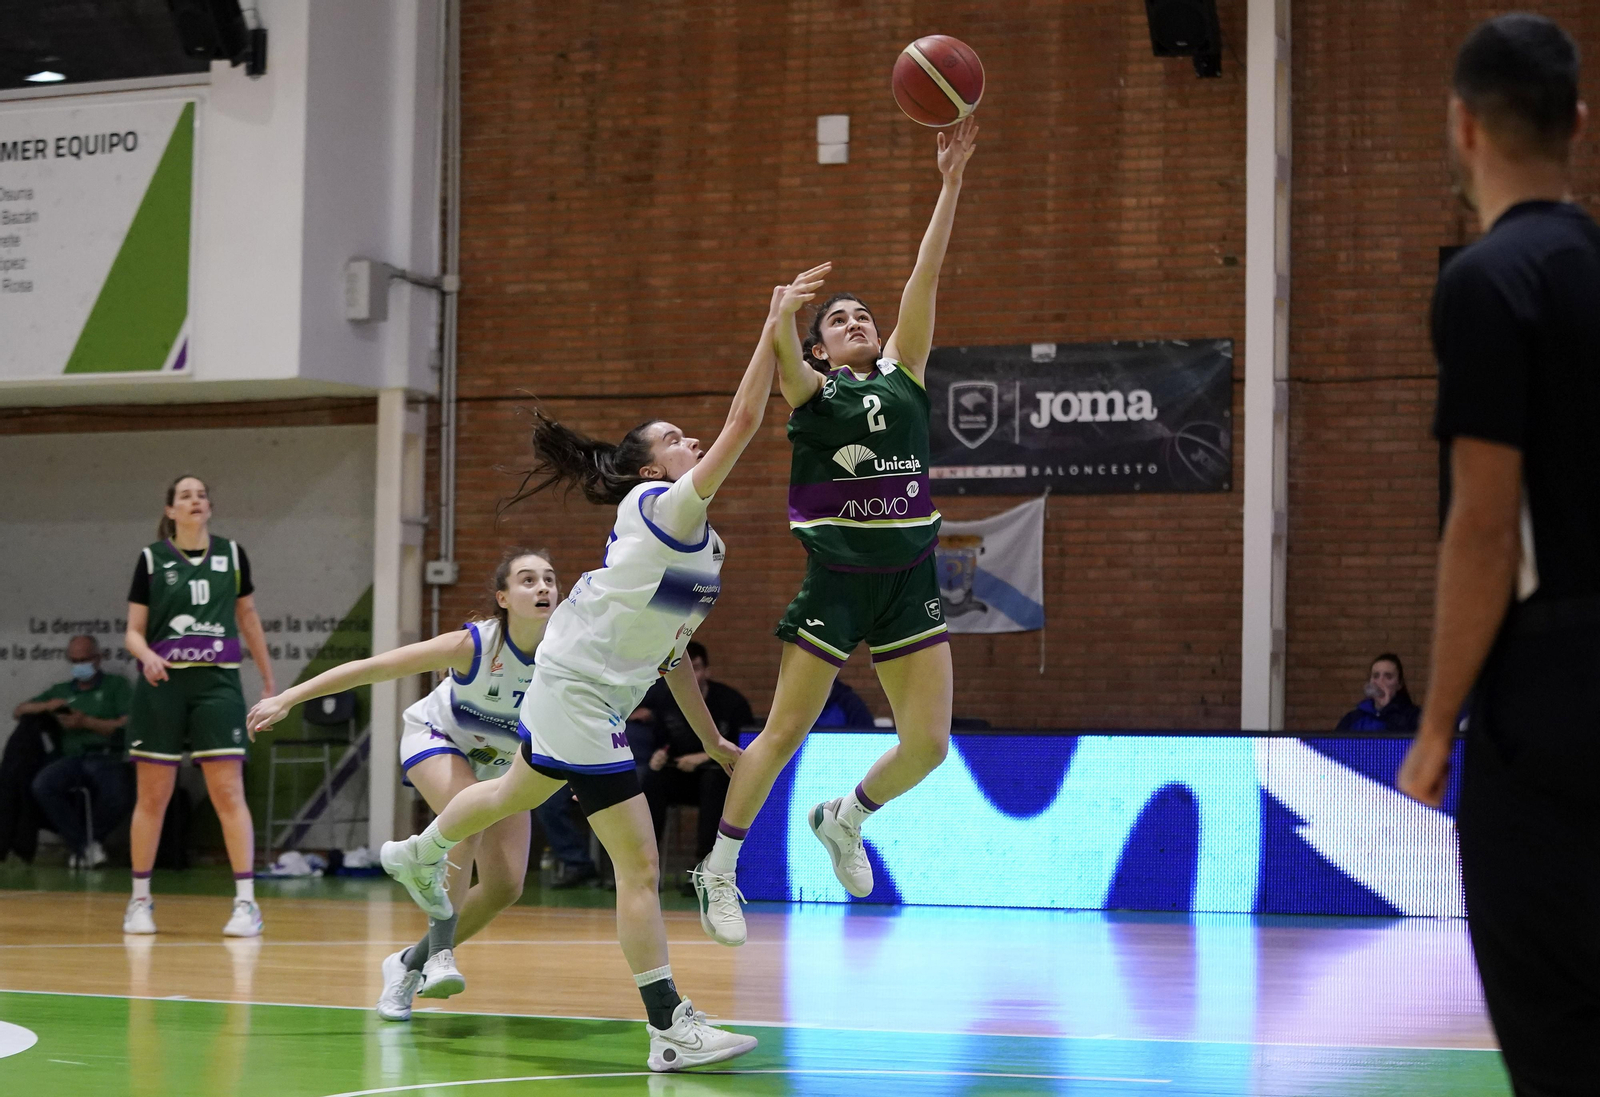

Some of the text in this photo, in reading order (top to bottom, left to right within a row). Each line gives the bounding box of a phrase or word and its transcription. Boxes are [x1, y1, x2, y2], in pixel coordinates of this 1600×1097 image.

[55, 131, 138, 160] EQUIPO
[862, 394, 887, 433] 2
[874, 454, 921, 472] Unicaja
[1031, 464, 1158, 476] BALONCESTO
[838, 497, 909, 517] ANOVO
[188, 579, 210, 605] 10
[512, 691, 525, 709] 7
